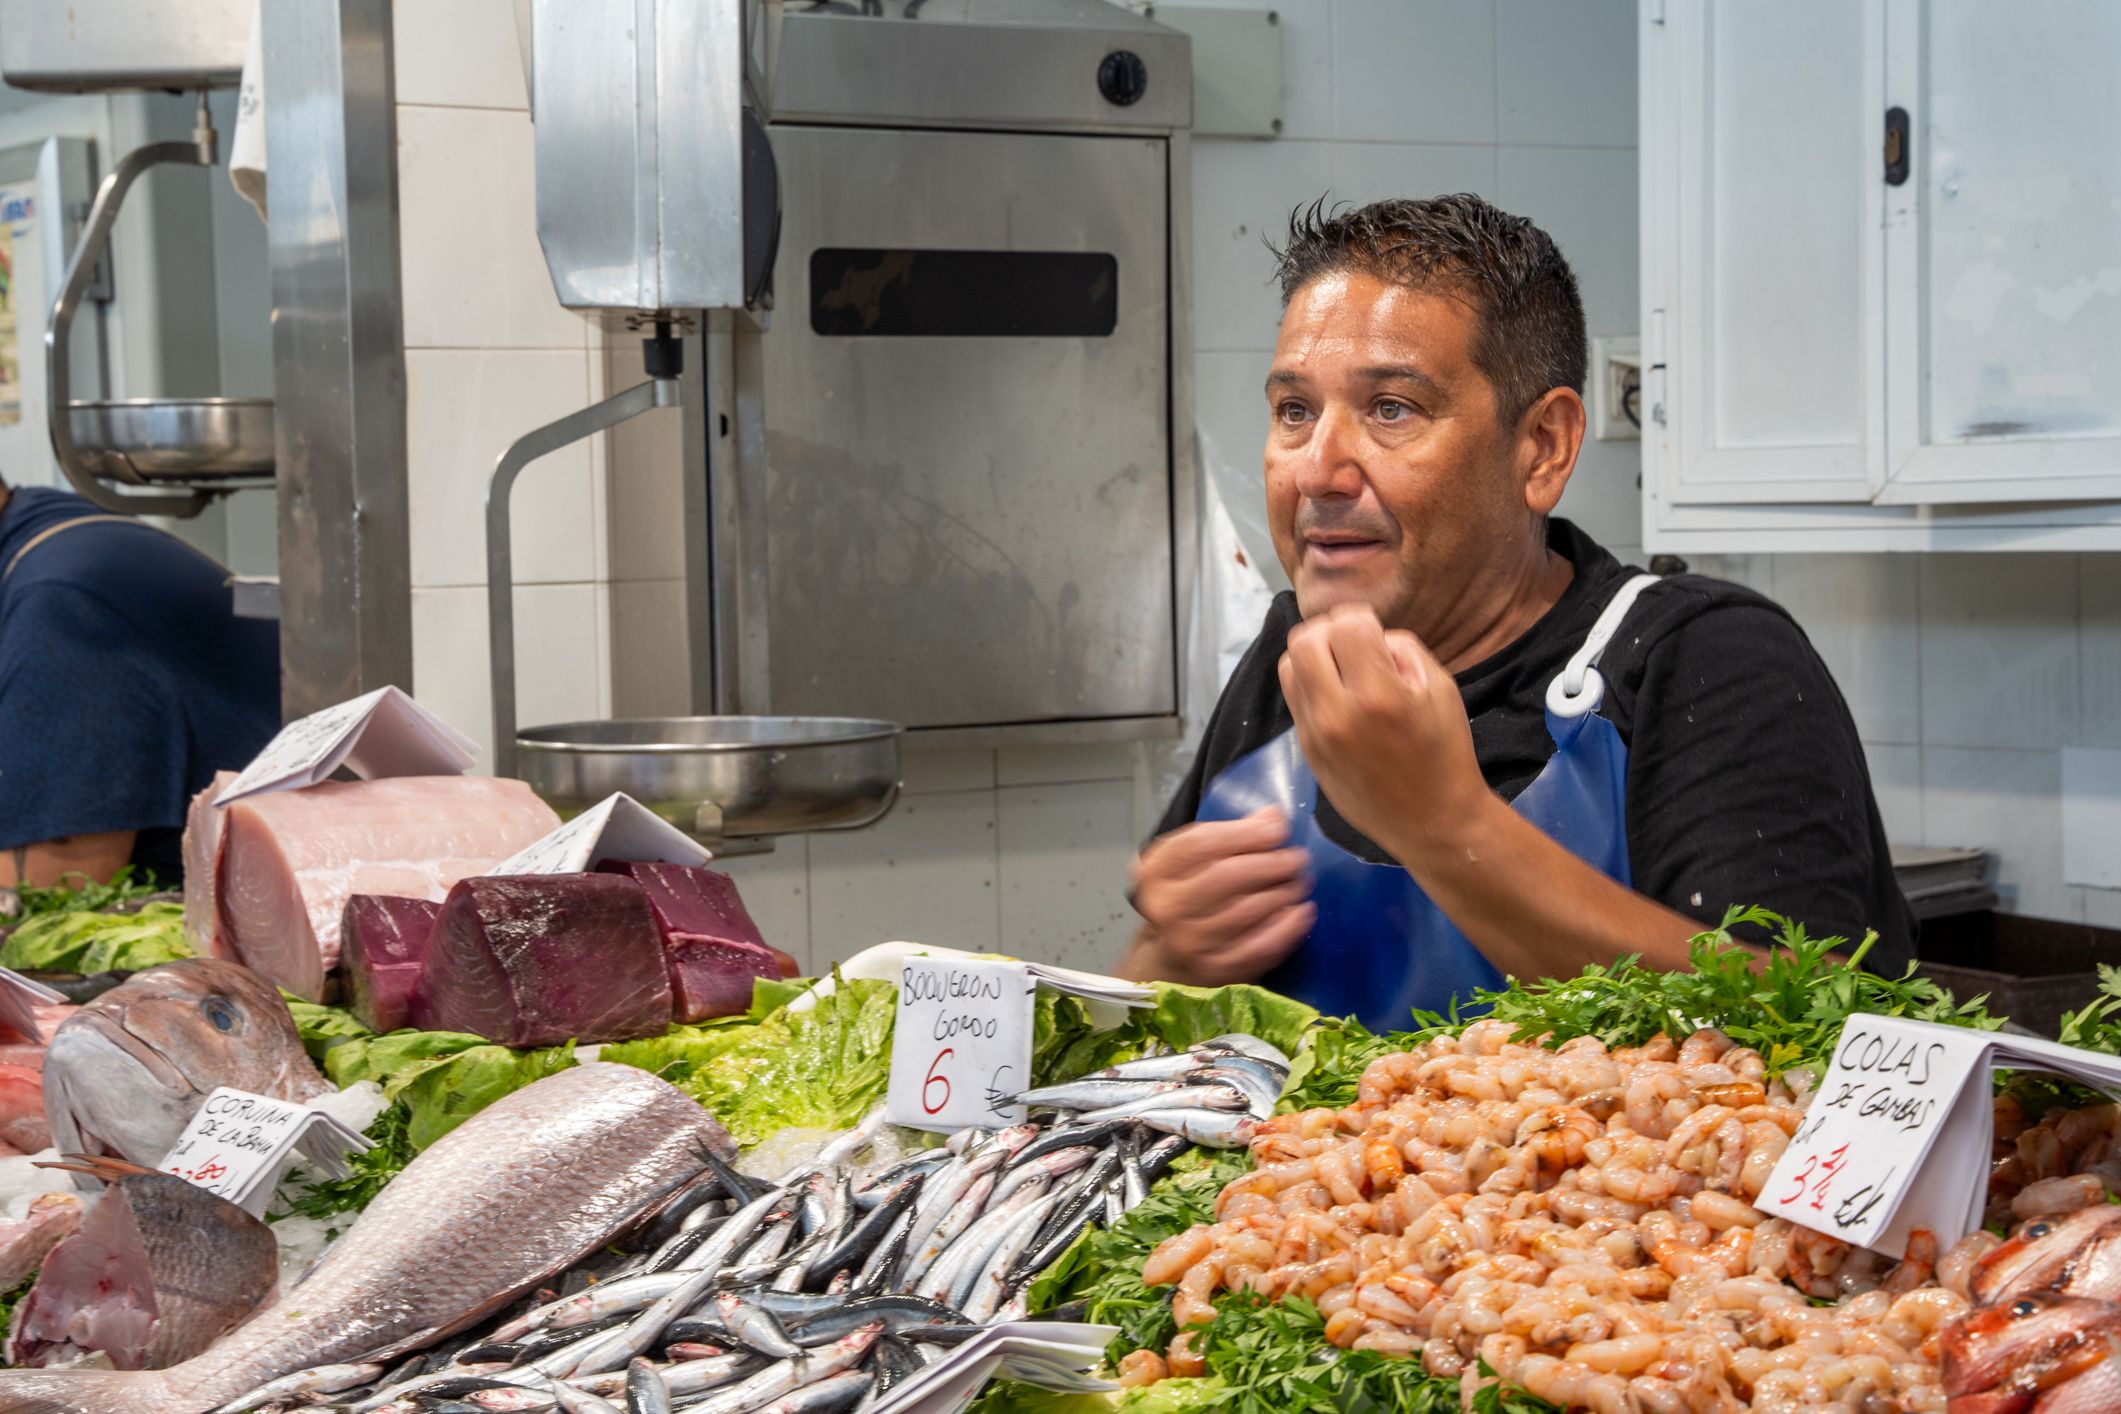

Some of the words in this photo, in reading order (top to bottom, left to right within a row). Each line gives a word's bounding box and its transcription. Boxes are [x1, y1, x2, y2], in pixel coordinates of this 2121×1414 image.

[1839, 1031, 1946, 1085] COLAS
[1825, 1083, 1866, 1109] DE
[1859, 1087, 1936, 1135] GAMBAS
